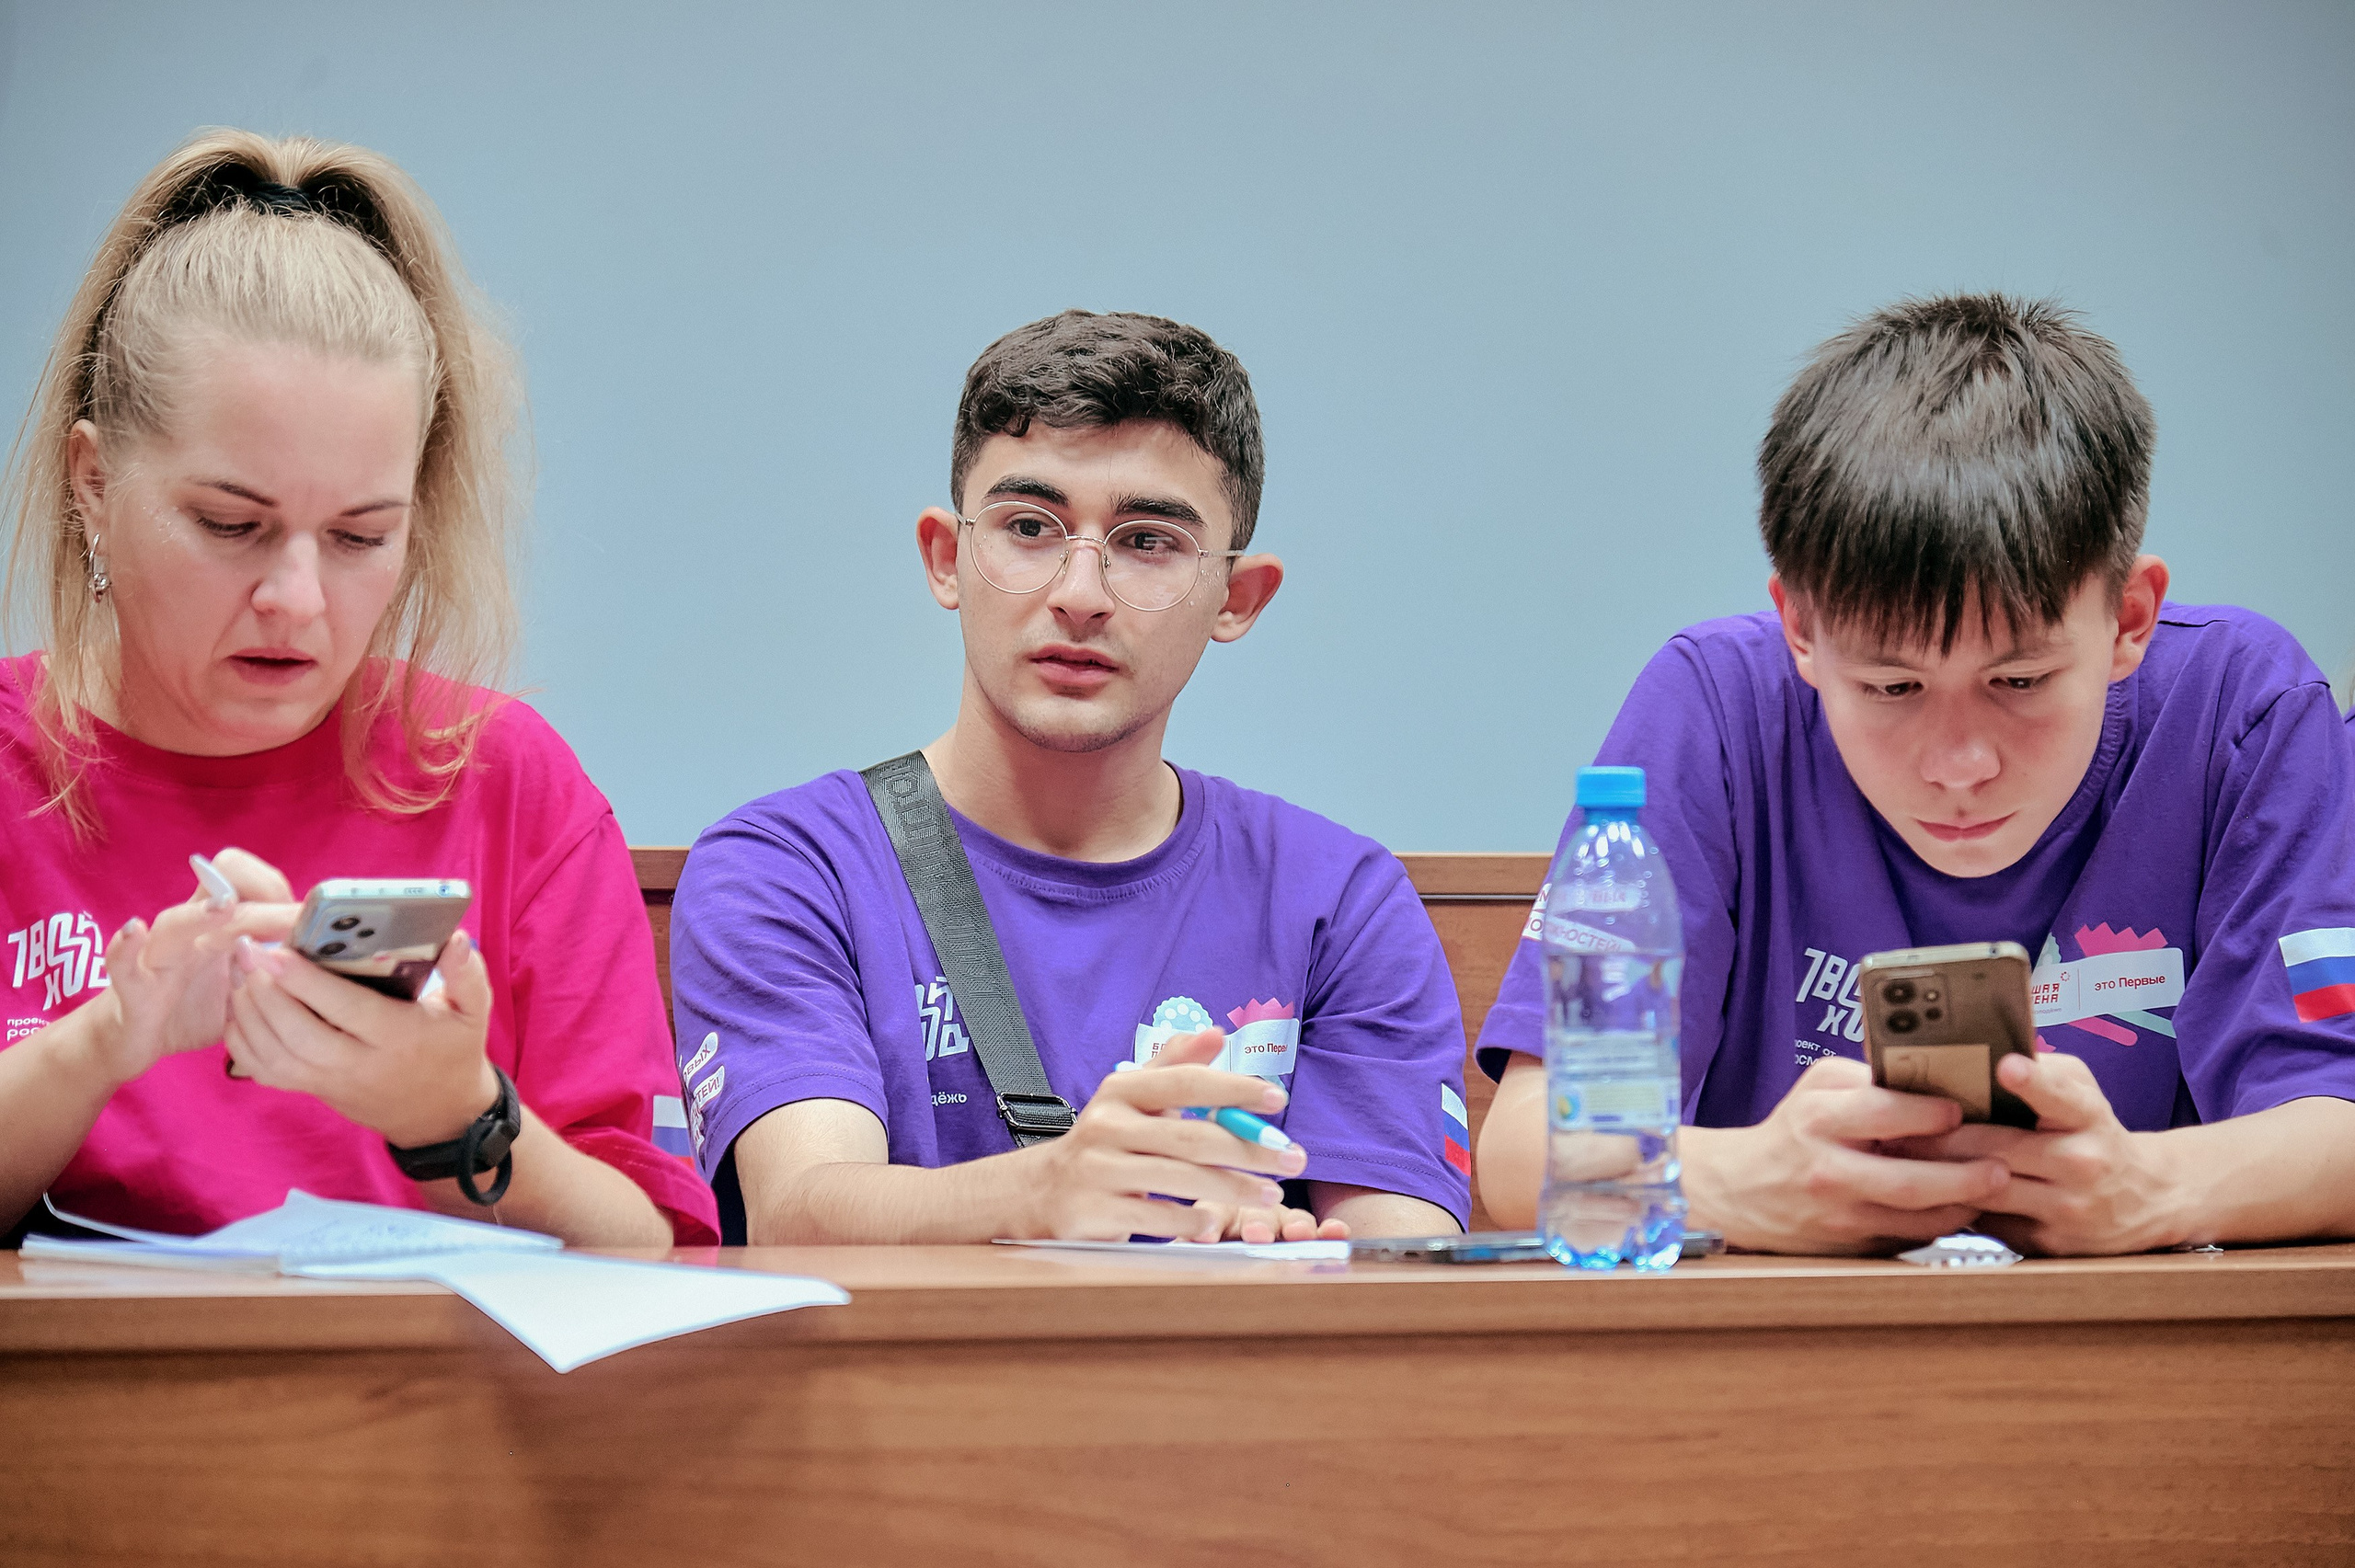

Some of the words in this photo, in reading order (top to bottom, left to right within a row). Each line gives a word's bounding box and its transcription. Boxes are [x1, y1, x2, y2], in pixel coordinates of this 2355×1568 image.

[2031, 982, 2061, 995] ШАЯ
[2094, 980, 2116, 991] это
[2119, 975, 2165, 990] Первые
[2032, 993, 2059, 1005] ЕНА
[1244, 1045, 1265, 1054] это
